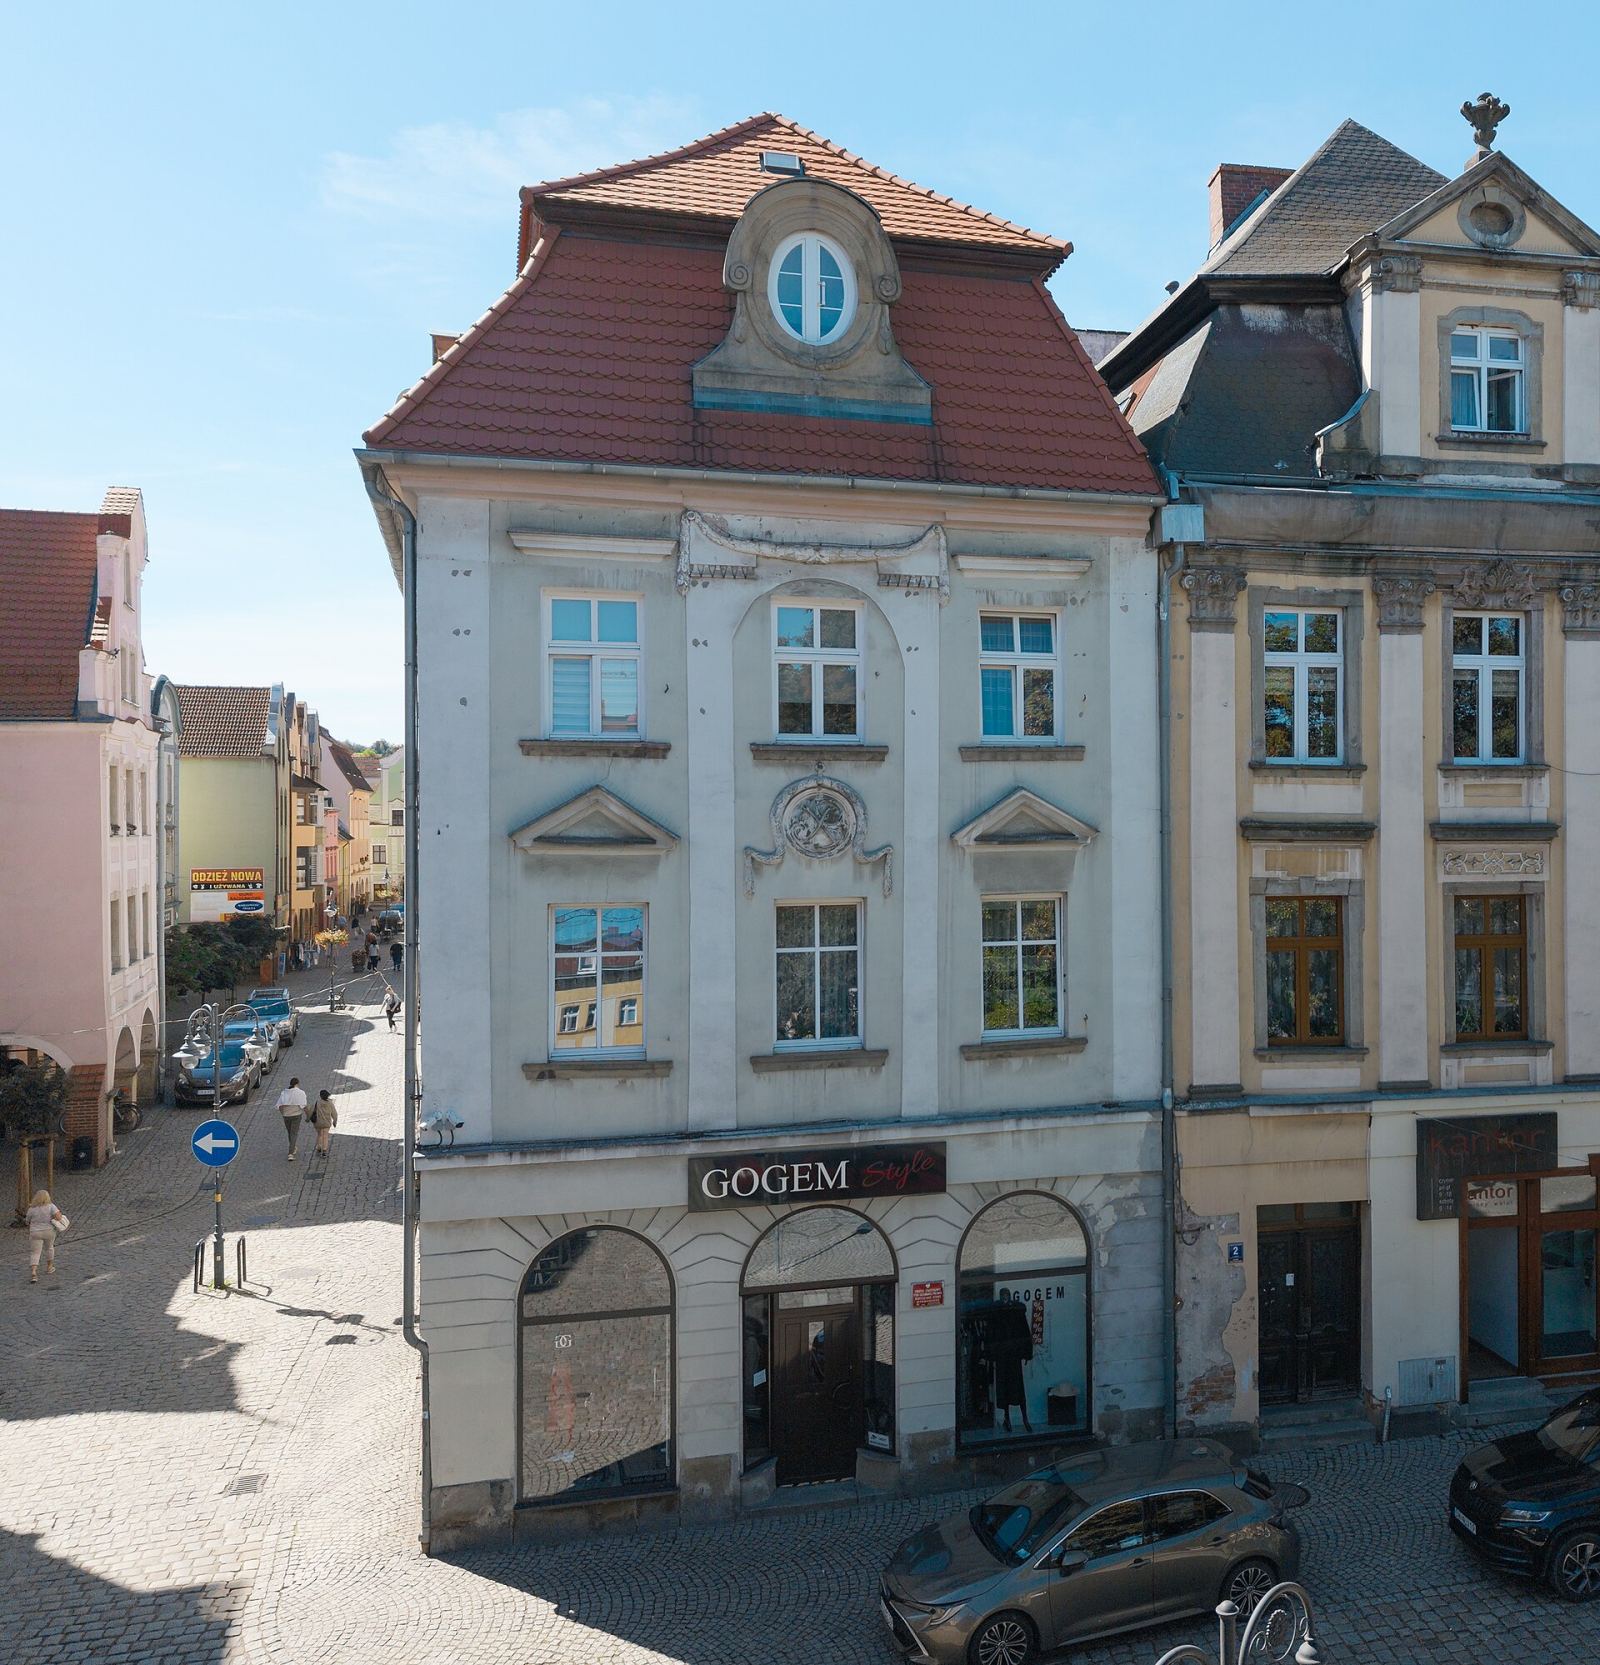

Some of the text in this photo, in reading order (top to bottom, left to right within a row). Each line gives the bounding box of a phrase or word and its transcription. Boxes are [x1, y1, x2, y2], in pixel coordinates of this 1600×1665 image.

[192, 869, 262, 882] ODZIEŻ NOWA
[701, 1150, 935, 1199] GOGEM Style
[1468, 1186, 1513, 1200] antor
[1233, 1246, 1239, 1255] 2
[1013, 1286, 1065, 1302] GOGEM
